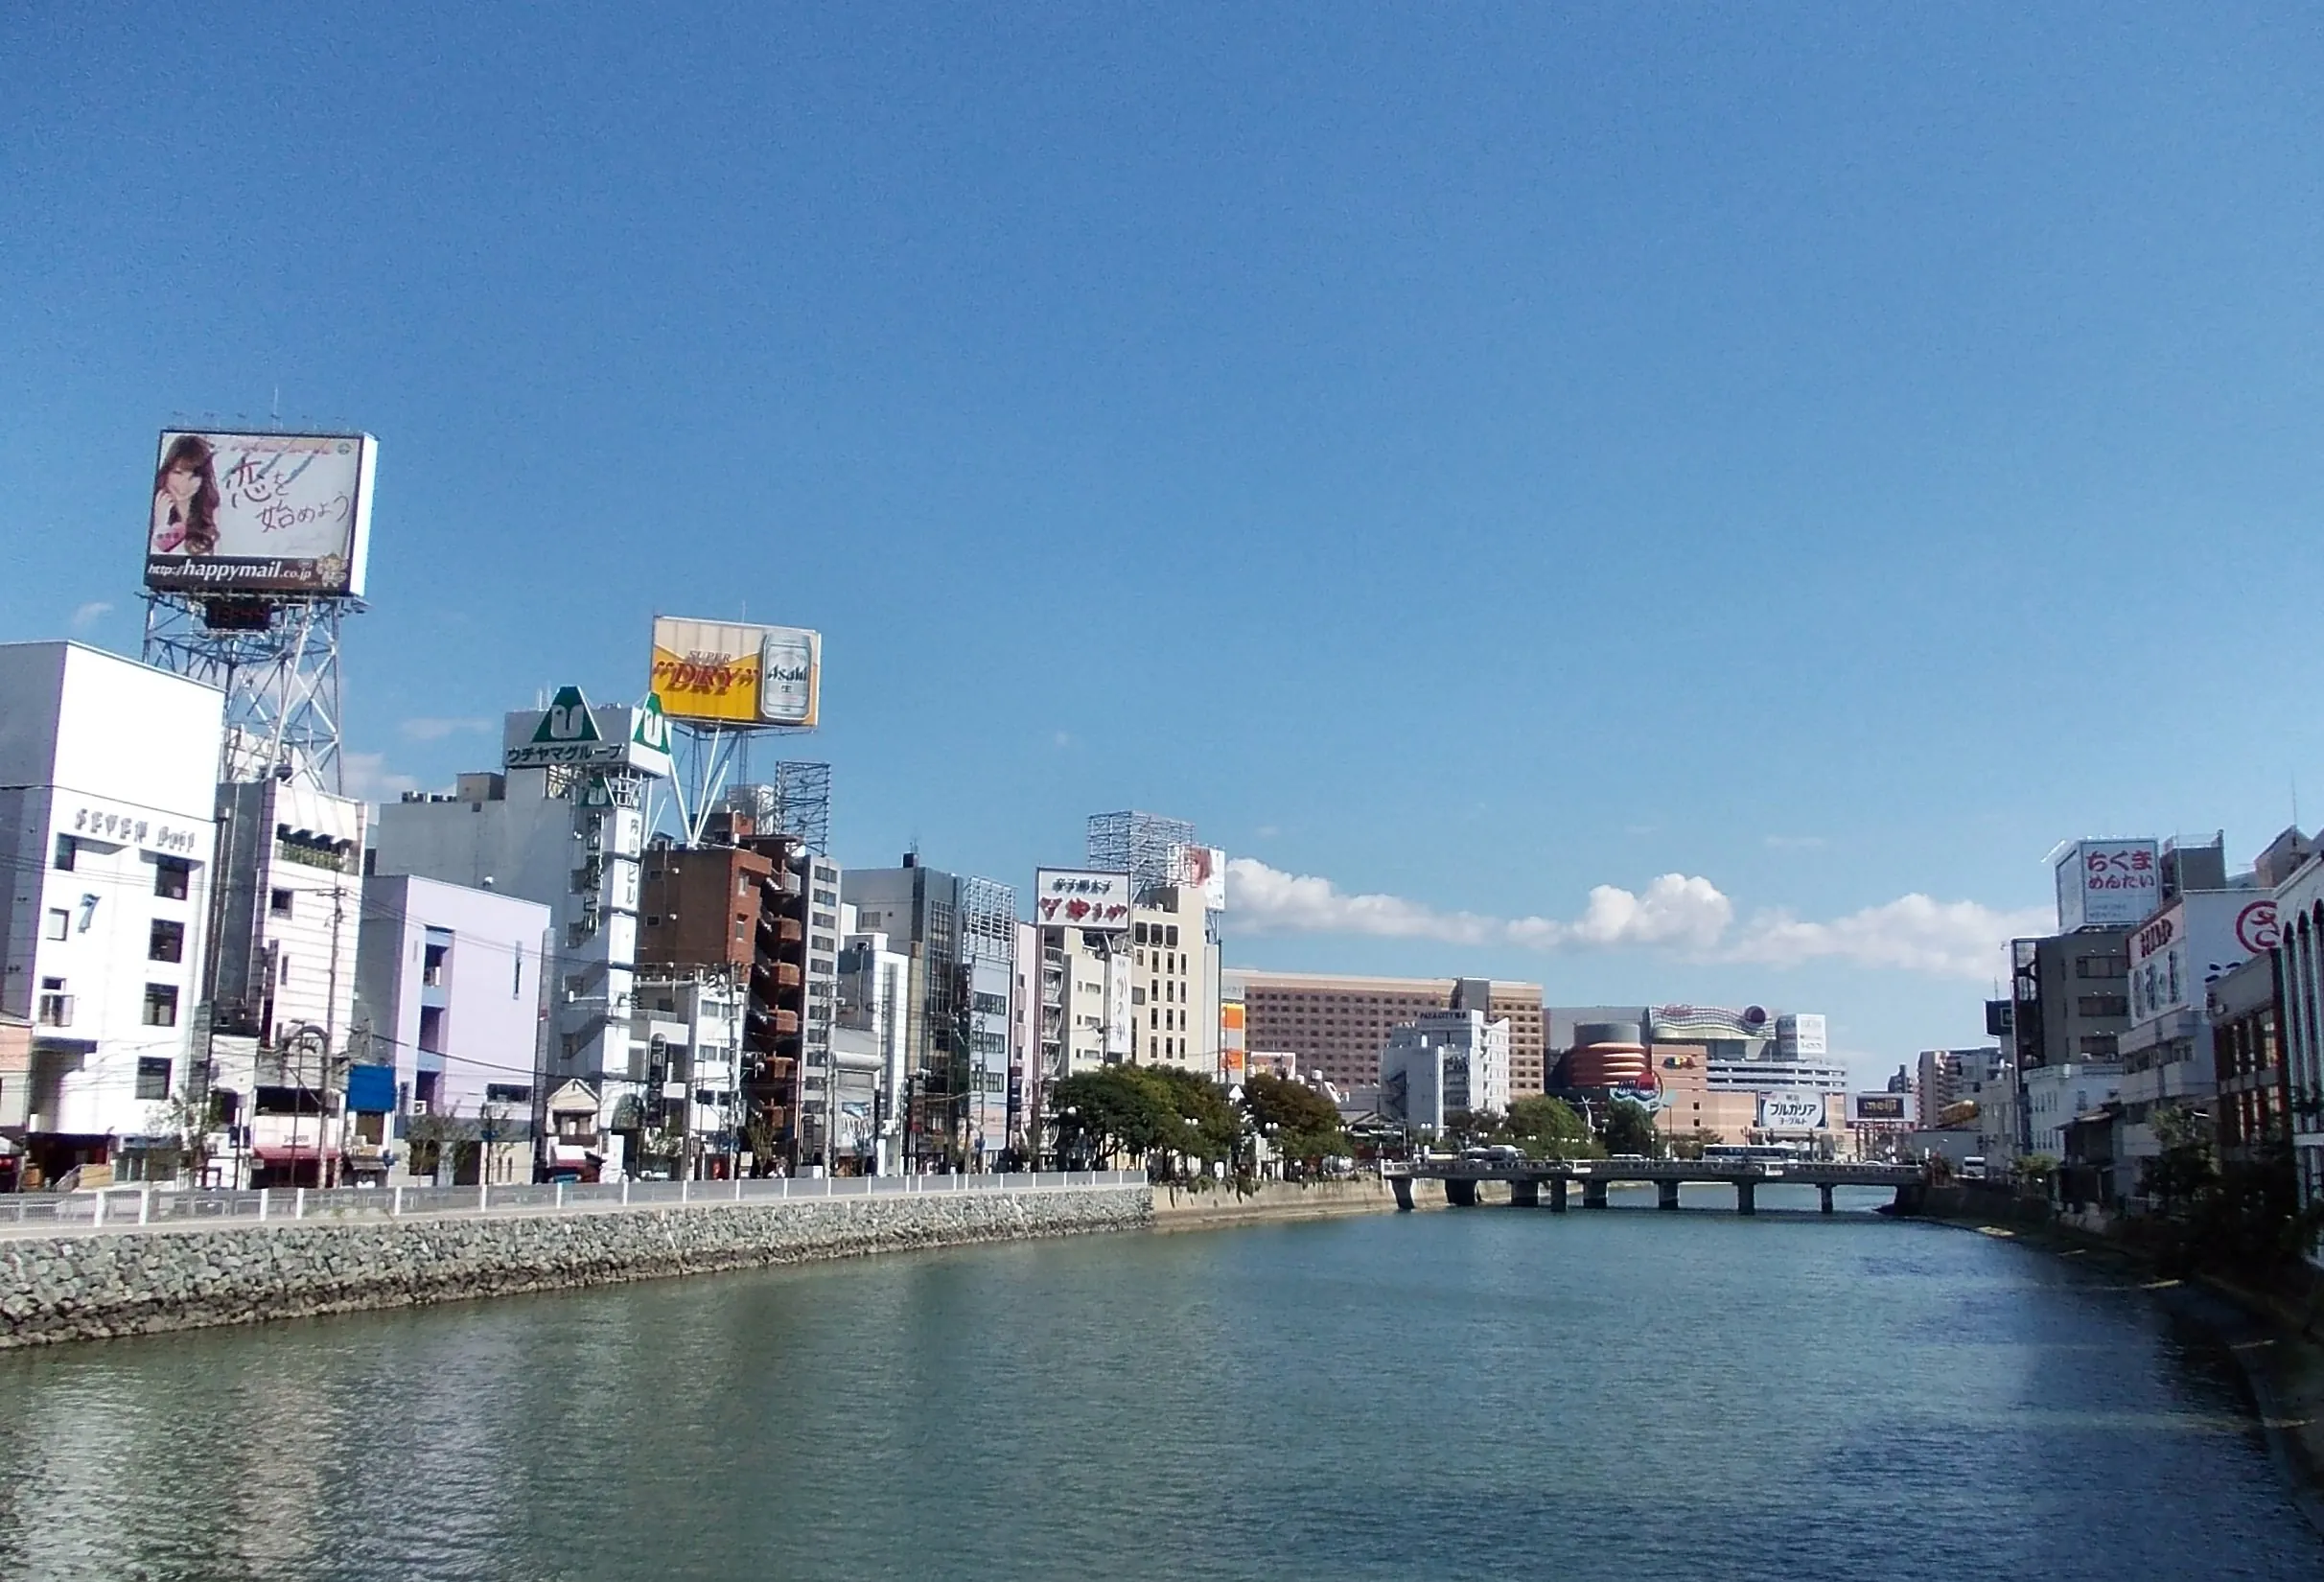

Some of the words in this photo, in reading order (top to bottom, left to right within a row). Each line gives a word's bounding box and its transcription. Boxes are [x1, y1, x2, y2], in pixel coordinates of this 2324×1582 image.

[255, 492, 350, 533] 始めよう
[688, 650, 732, 663] SUPER
[767, 663, 808, 682] Asahi
[506, 743, 625, 764] ウチヤマグループ
[2086, 850, 2153, 872] ちくま
[2088, 873, 2155, 890] めんたい
[1864, 1099, 1897, 1112] meiji
